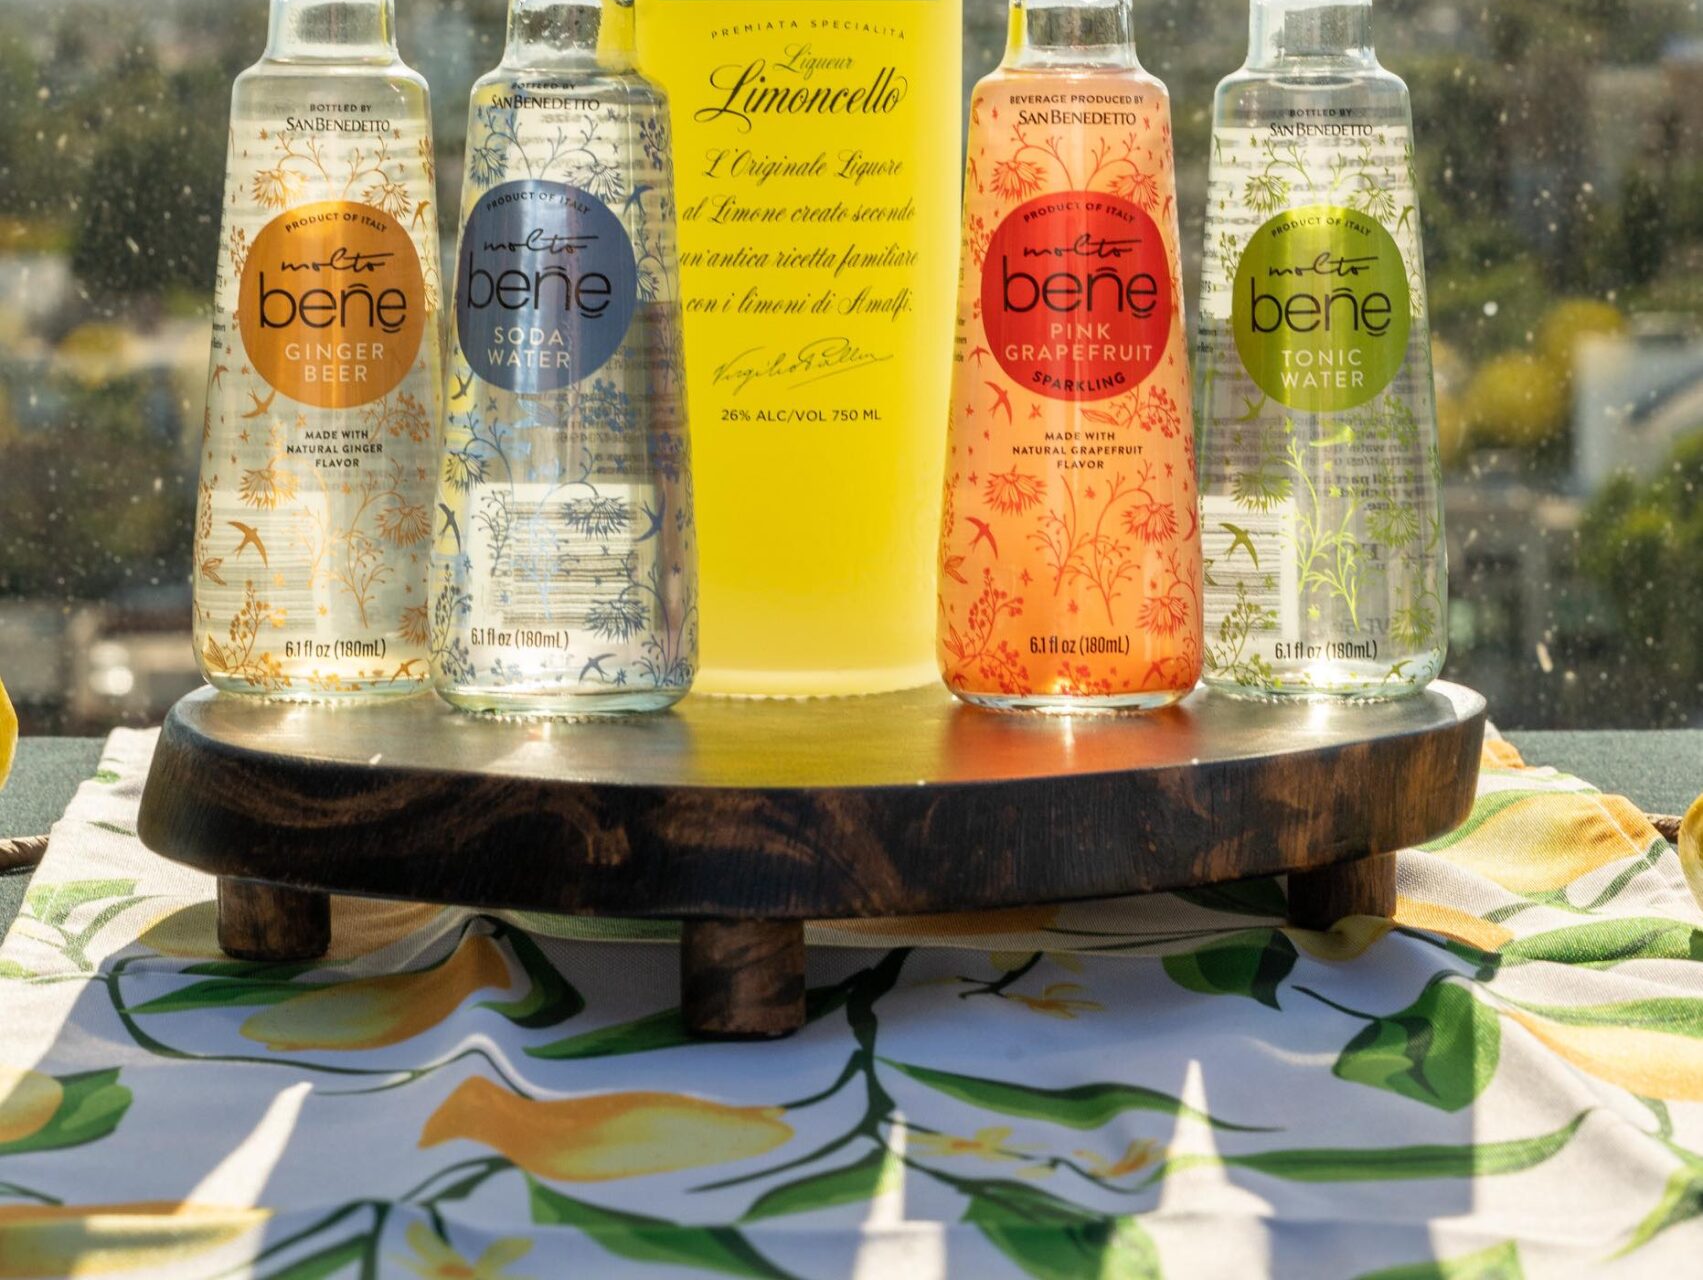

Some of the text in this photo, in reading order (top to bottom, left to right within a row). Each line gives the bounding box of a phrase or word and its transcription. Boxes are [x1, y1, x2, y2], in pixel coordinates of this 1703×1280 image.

[711, 20, 798, 39] PREMIATA
[773, 43, 854, 81] Liqueur
[693, 58, 908, 134] Limoncello
[1010, 95, 1144, 104] BEVERAGE PRODUCED BY
[310, 104, 372, 113] BOTTLED BY
[1289, 108, 1352, 117] BOTTLED BY
[704, 147, 903, 186] L'Originale Liquore
[486, 191, 591, 215] PRODUCT OF ITALY
[682, 194, 917, 225] al Limone creato secondo
[1023, 202, 1136, 223] PRODUCT OF ITALY
[285, 212, 388, 233] PRODUCT OF ITALY
[1271, 217, 1320, 237] PRODUCT
[1326, 217, 1341, 226] OF
[1345, 219, 1371, 237] ITALY
[484, 228, 599, 254] molto
[1023, 233, 1142, 258] molto
[281, 247, 394, 272] molto
[776, 246, 837, 269] ricetta
[834, 243, 919, 278] familiare
[1268, 252, 1378, 277] molto
[686, 297, 717, 313] con
[721, 292, 735, 313] i
[737, 286, 810, 314] limoni
[811, 289, 836, 314] di
[494, 327, 564, 346] SODA
[1051, 323, 1111, 340] PINK
[285, 343, 384, 361] GINGER
[488, 348, 570, 368] WATER
[1005, 344, 1153, 361] GRAPEFRUIT
[1282, 349, 1362, 367] TONIC
[304, 365, 367, 382] BEER
[1032, 371, 1126, 393] SPARKLING
[1280, 370, 1364, 389] WATER
[721, 409, 882, 424] 26% ALC/VOL 750 ML
[305, 430, 369, 440] MADE WITH
[1045, 432, 1115, 441] MADE WITH
[287, 444, 383, 454] NATURAL GINGER
[1012, 446, 1143, 455] NATURAL GRAPEFRUIT
[315, 459, 359, 467] FLAVOR
[1057, 460, 1104, 469] FLAVOR
[285, 638, 386, 659] 6.1 fl oz (180mL)
[471, 627, 570, 650] 6.1 fl oz (180mL)
[1030, 635, 1130, 656] 6.1 fl oz (180mL)
[1275, 642, 1291, 660] 6.1
[1295, 642, 1304, 660] fl
[1326, 639, 1377, 660] (180mL)
